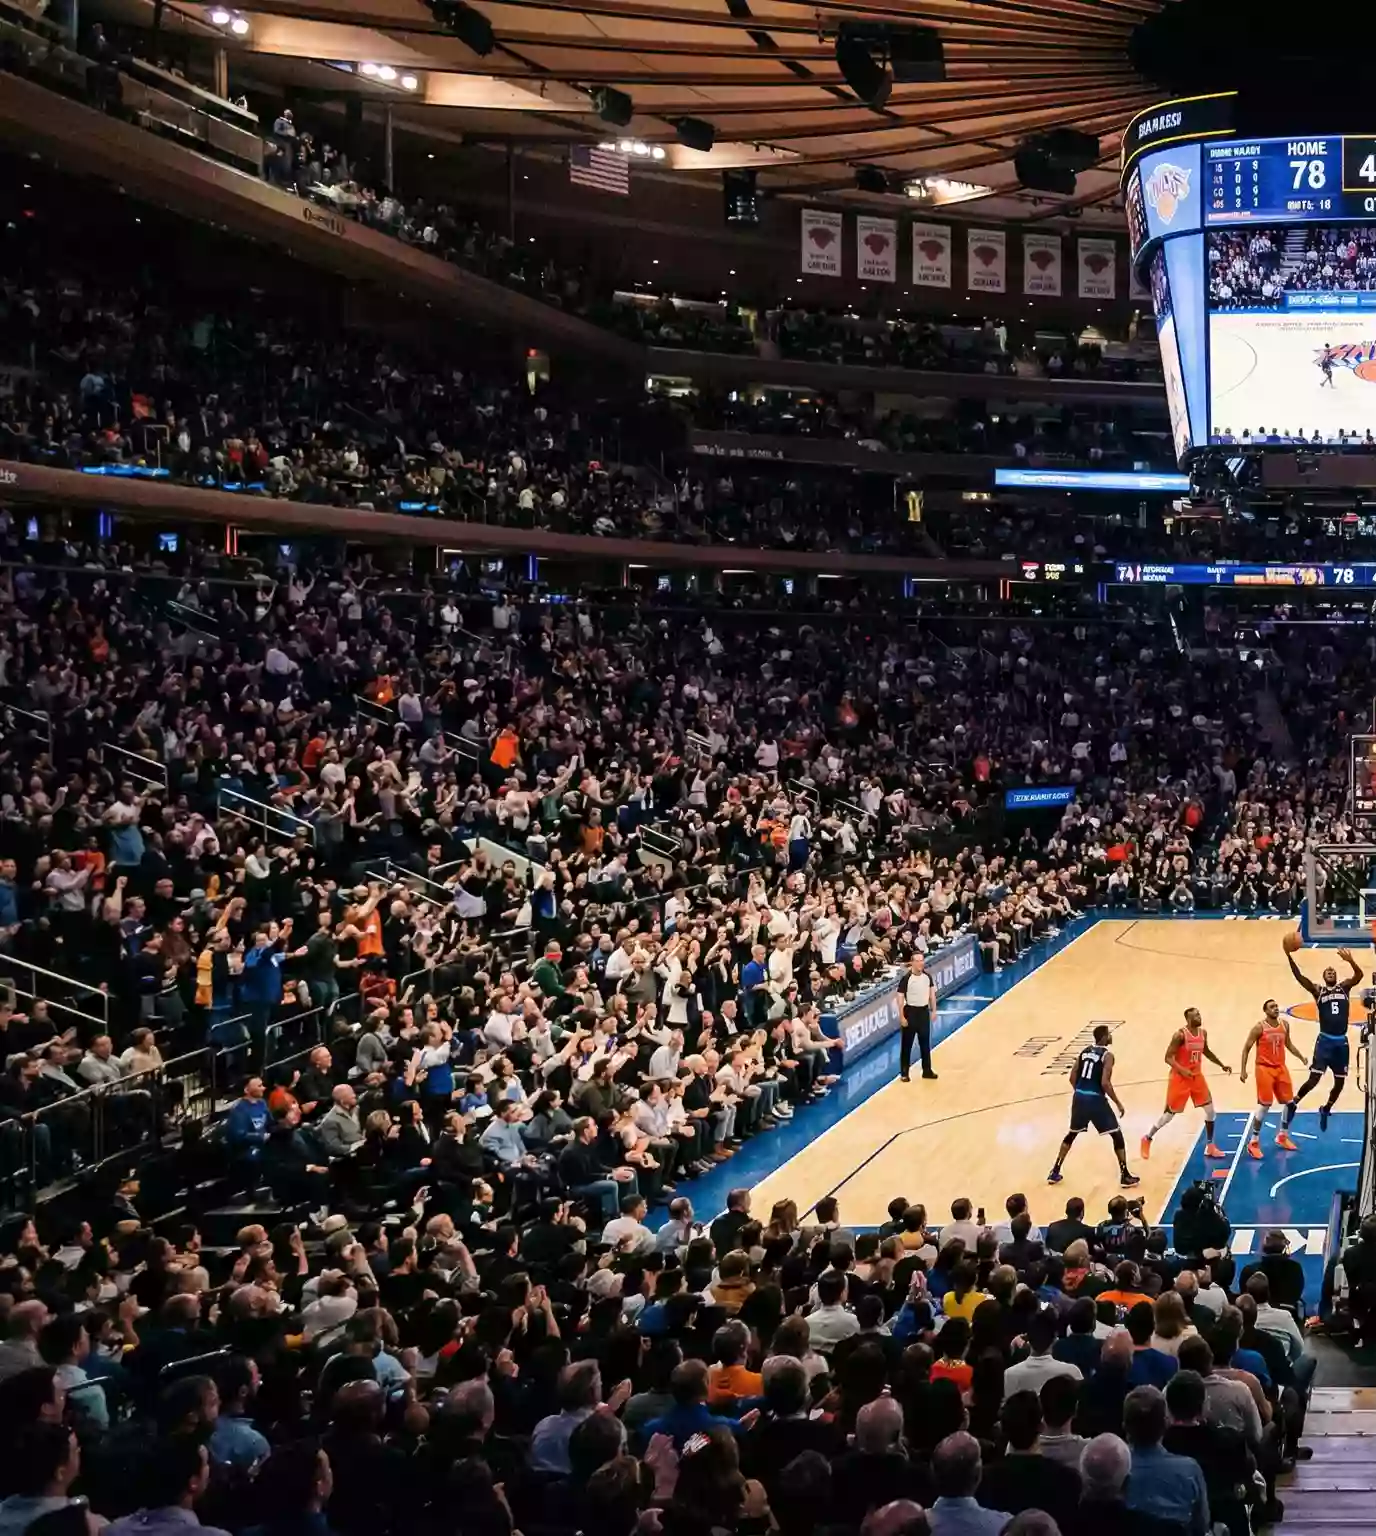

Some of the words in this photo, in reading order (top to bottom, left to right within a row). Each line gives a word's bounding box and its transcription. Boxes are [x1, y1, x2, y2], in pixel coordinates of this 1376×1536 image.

[1289, 160, 1326, 190] 78
[1333, 568, 1354, 584] 78
[1081, 1060, 1094, 1080] 11
